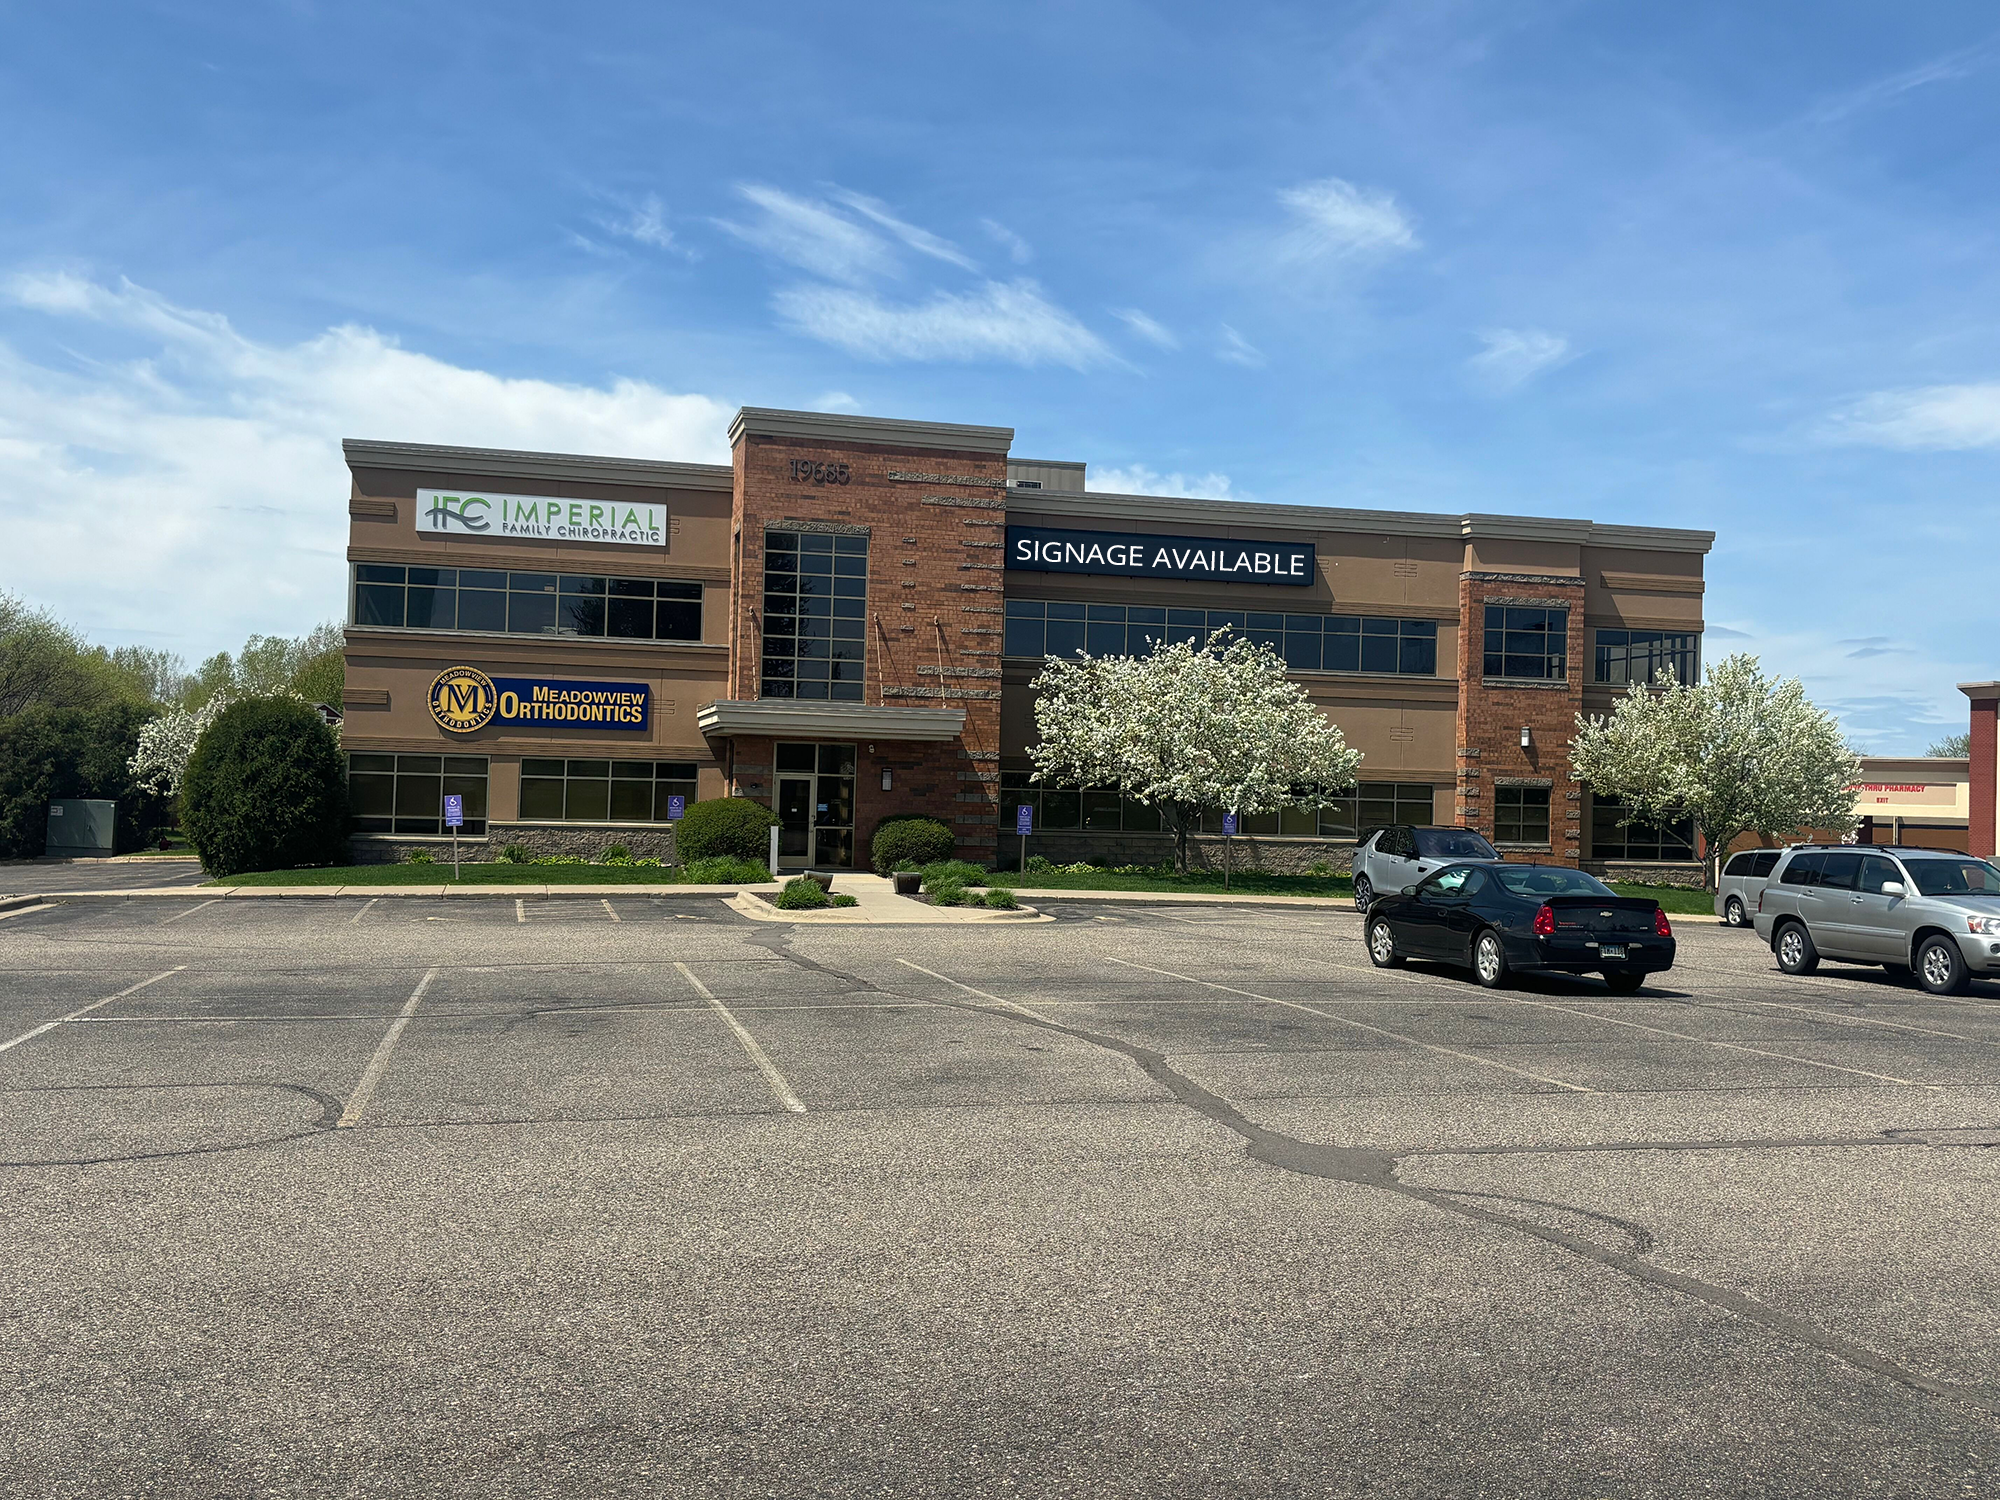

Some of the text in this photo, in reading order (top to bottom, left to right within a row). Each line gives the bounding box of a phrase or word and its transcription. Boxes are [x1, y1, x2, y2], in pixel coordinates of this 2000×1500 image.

[790, 459, 849, 485] 19685
[503, 499, 660, 531] IMPERIAL
[502, 522, 660, 543] FAMILY CHIROPRACTIC
[1016, 539, 1305, 576] SIGNAGE AVAILABLE
[440, 670, 487, 686] MEADOWVIEW
[499, 691, 643, 723] ORTHODONTICS
[533, 686, 645, 705] MEADOWVIEW
[432, 700, 492, 728] ORTHODONTICS
[1884, 785, 1926, 793] PHARMACY
